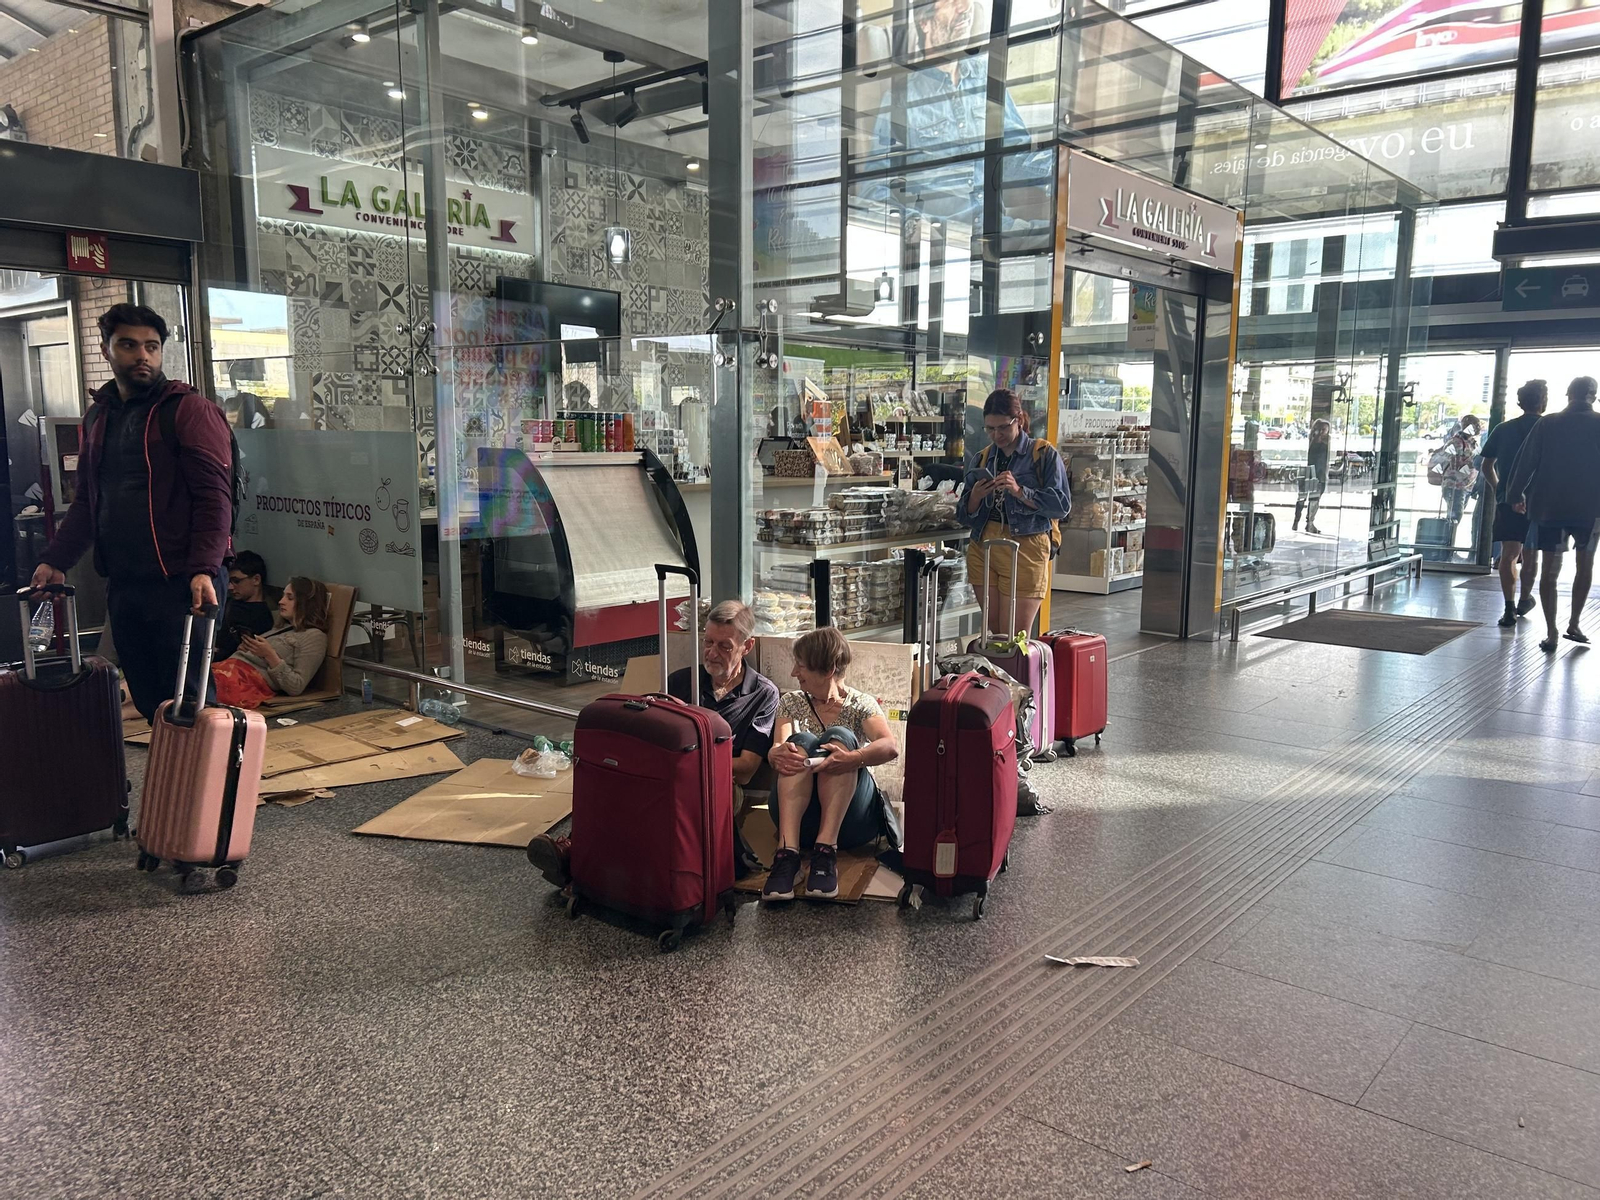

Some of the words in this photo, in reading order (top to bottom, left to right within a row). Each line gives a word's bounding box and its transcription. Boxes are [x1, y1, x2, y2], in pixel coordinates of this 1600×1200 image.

[1330, 121, 1475, 162] yo.eu
[1571, 116, 1584, 131] o
[320, 175, 361, 209] LA
[1116, 188, 1138, 223] LA
[447, 226, 464, 236] ORE
[256, 494, 321, 517] PRODUCTOS
[323, 496, 371, 522] TÍPICOS
[297, 519, 305, 527] DE
[304, 519, 326, 530] ESPAÑA
[370, 619, 390, 631] tiend
[462, 637, 490, 652] tiendas
[520, 649, 551, 664] tiendas
[535, 663, 552, 671] estación
[584, 661, 619, 678] tiendas
[601, 677, 619, 685] estación
